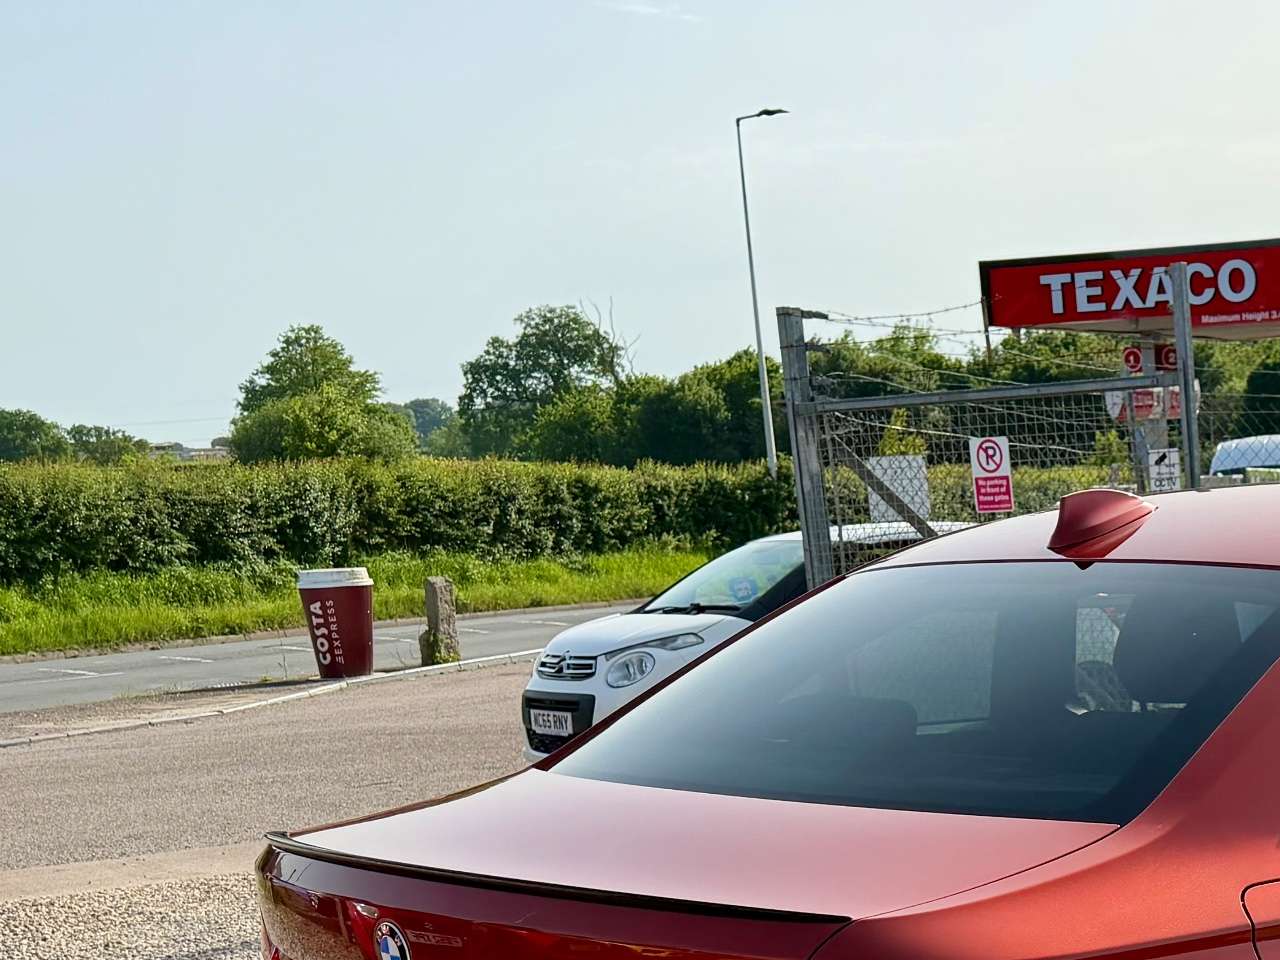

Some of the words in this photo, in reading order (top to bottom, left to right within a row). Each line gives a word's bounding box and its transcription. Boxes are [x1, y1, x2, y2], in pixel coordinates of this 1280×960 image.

[1040, 258, 1257, 315] TEXACO
[1201, 313, 1240, 323] Maximum
[1241, 310, 1269, 322] Height
[1154, 477, 1177, 489] CCTV
[310, 601, 332, 665] COSTA
[326, 600, 344, 656] EXPRESS
